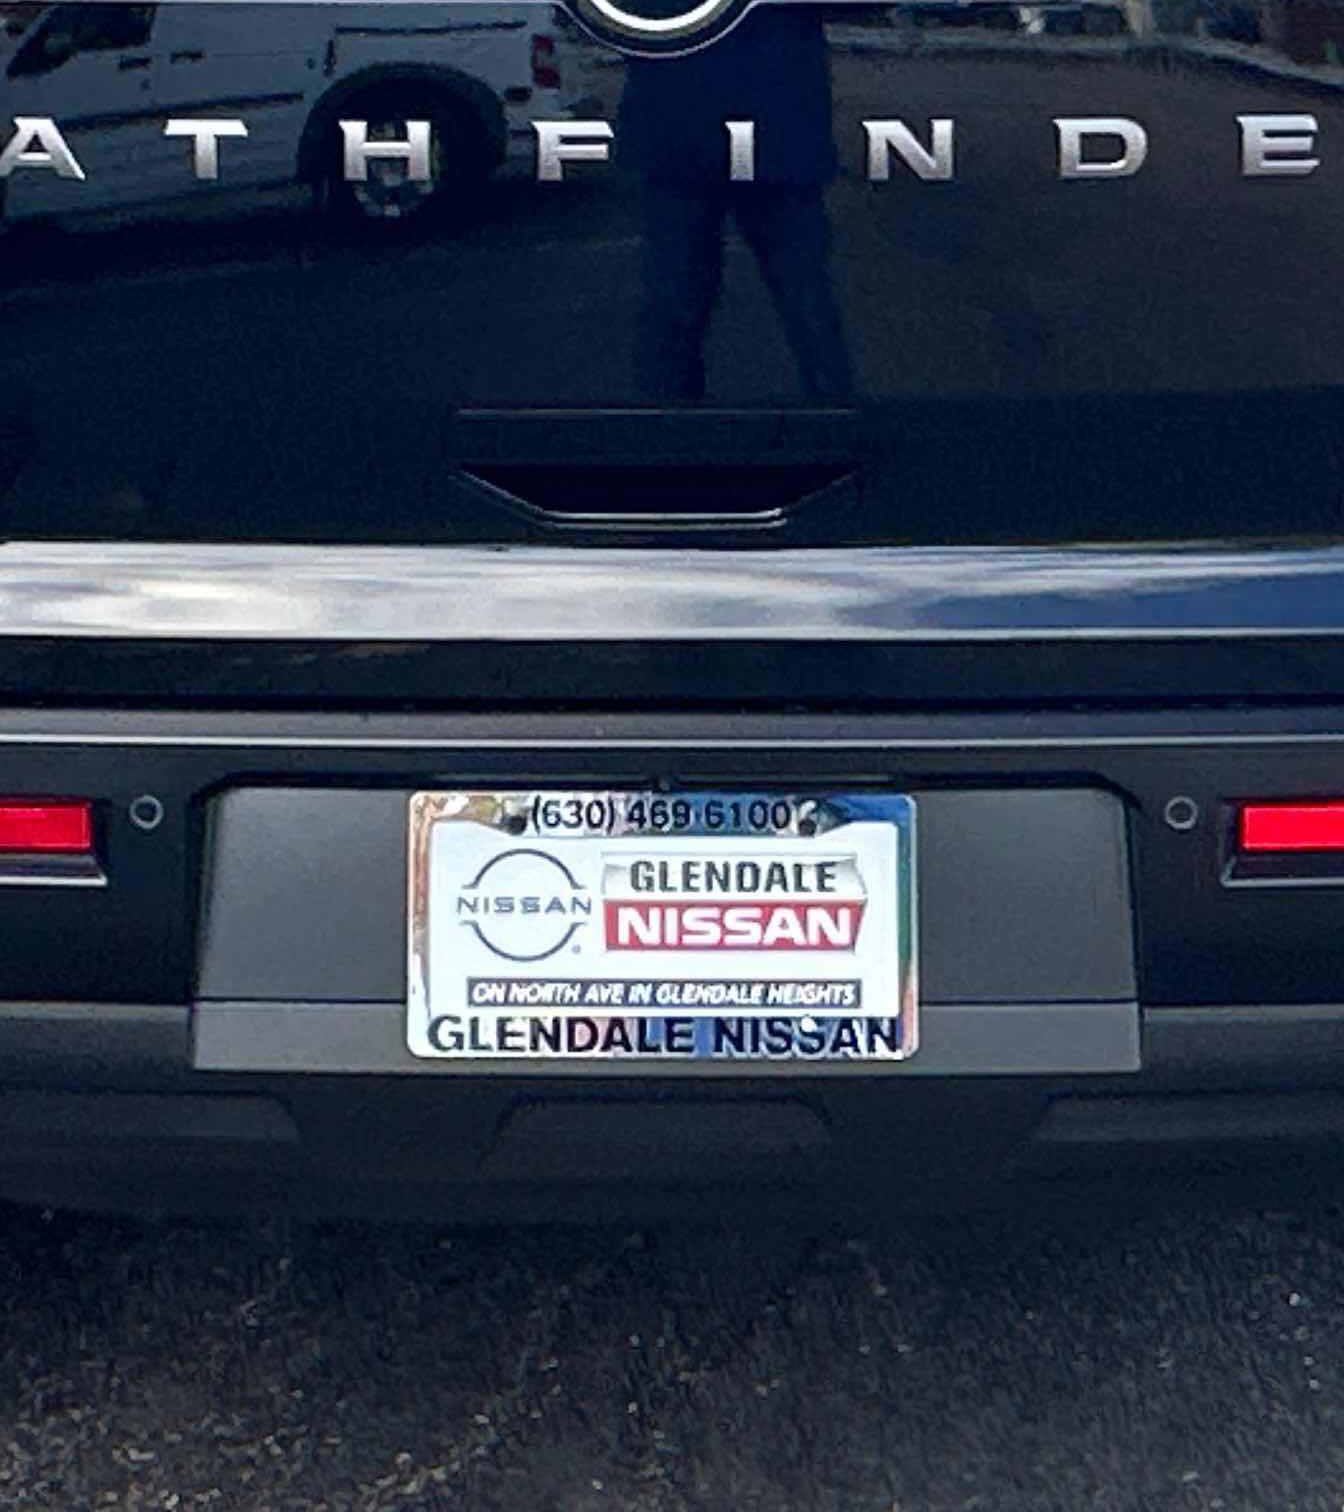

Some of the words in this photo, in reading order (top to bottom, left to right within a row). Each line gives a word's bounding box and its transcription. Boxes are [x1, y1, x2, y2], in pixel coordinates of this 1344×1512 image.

[532, 795, 616, 835] (630)
[630, 860, 838, 893] GLENDALE
[457, 896, 592, 914] NISSAN
[617, 908, 853, 945] NISSAN
[472, 983, 505, 1004] ON
[508, 983, 579, 1004] NORTH
[584, 983, 624, 1004] AVE
[628, 983, 654, 1004] IN
[656, 983, 763, 1005] GLENDALE
[767, 984, 856, 1006] HEIGHTS
[427, 1016, 695, 1053] GLENDALE
[713, 1017, 898, 1054] NISSAN
